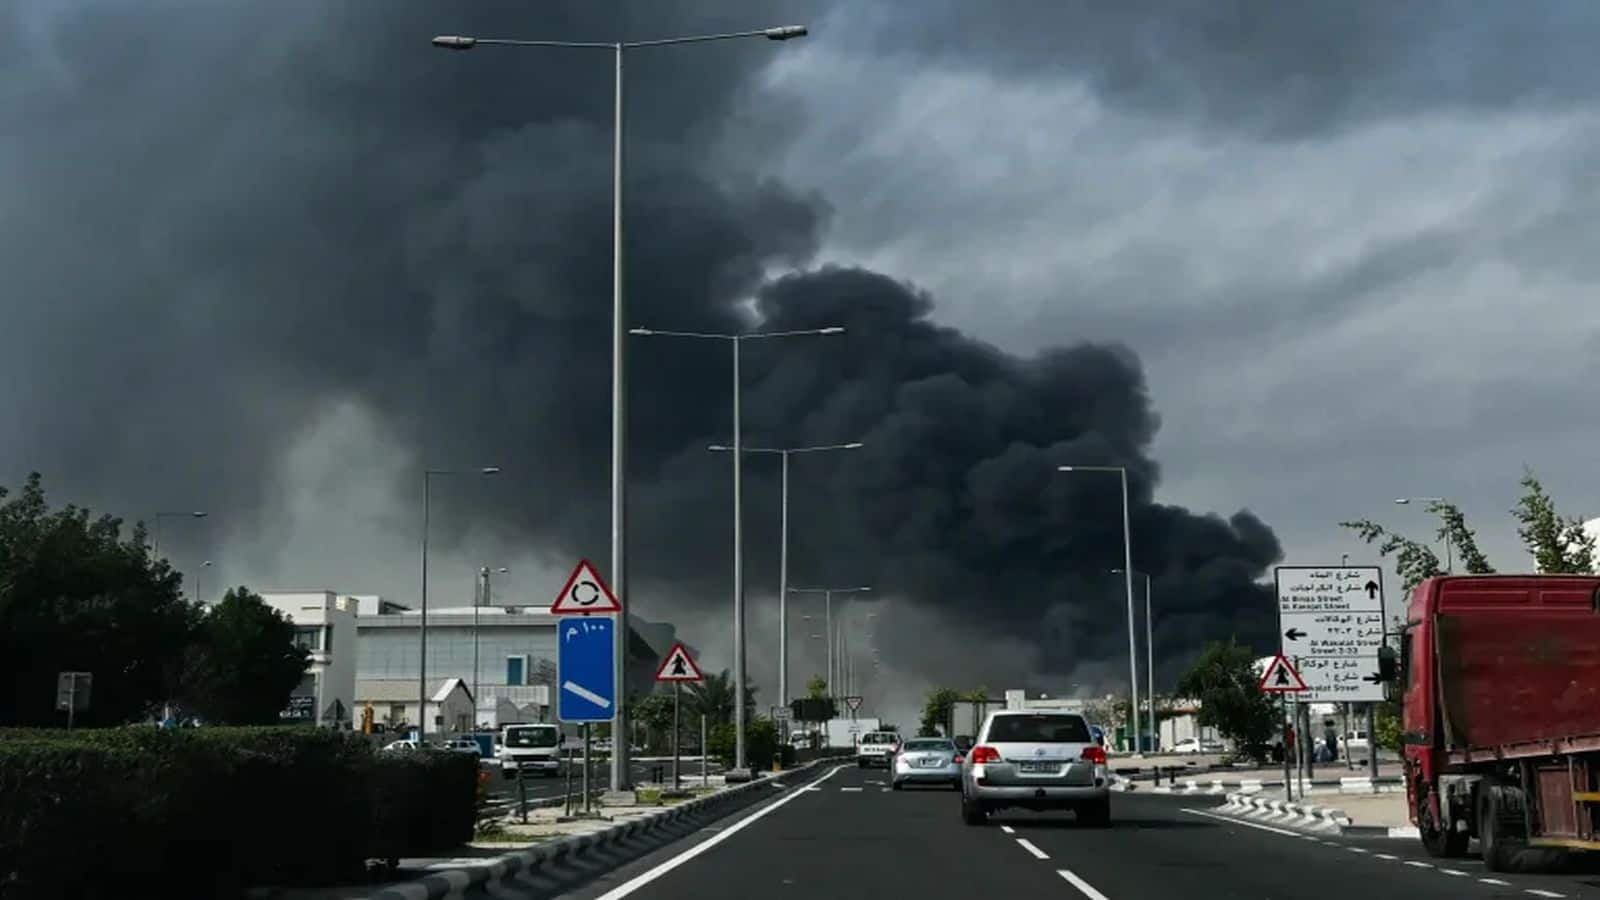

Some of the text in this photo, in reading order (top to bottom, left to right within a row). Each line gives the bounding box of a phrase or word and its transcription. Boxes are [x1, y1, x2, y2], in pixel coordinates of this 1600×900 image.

[1337, 584, 1362, 594] شارع
[1356, 614, 1380, 624] شارع
[1357, 628, 1382, 638] شارع
[1334, 660, 1358, 670] شارع
[1334, 673, 1359, 682] شارع
